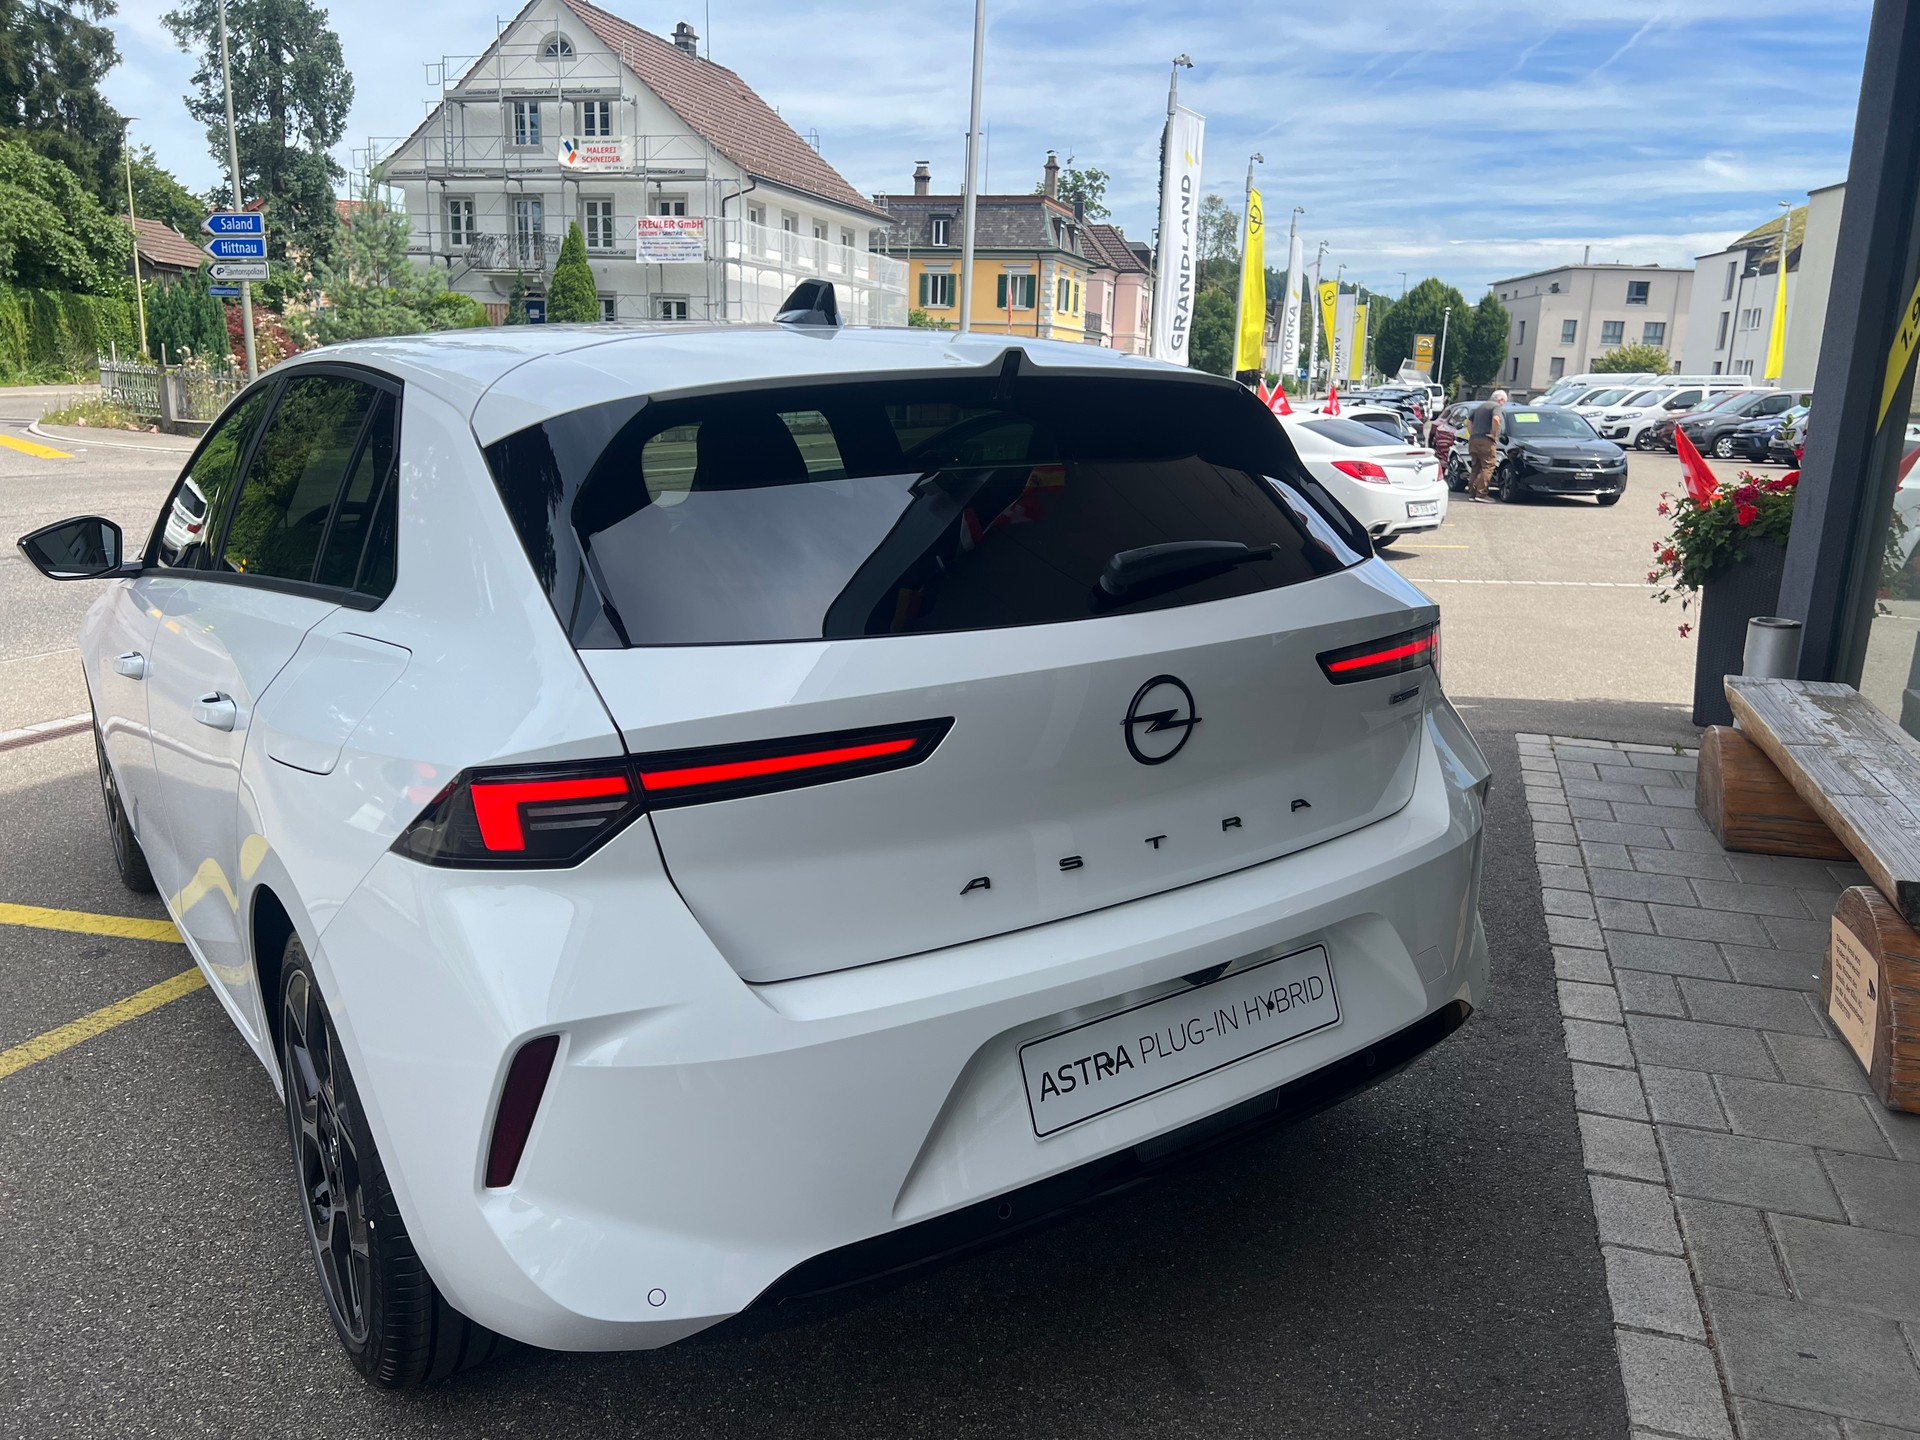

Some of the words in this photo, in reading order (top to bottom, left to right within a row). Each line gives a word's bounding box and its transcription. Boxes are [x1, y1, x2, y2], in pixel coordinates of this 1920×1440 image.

[221, 217, 253, 230] Saland
[221, 241, 257, 254] Hittnau
[638, 220, 675, 229] FREULER
[678, 220, 704, 229] GmbH
[1171, 174, 1191, 351] GRANDLAND
[1283, 306, 1297, 365] MOKKA
[960, 798, 1311, 896] ASTRA
[1040, 1045, 1135, 1102] ASTRA
[1139, 1005, 1239, 1064] PLUG-IN
[1246, 975, 1324, 1025] HYBRID
